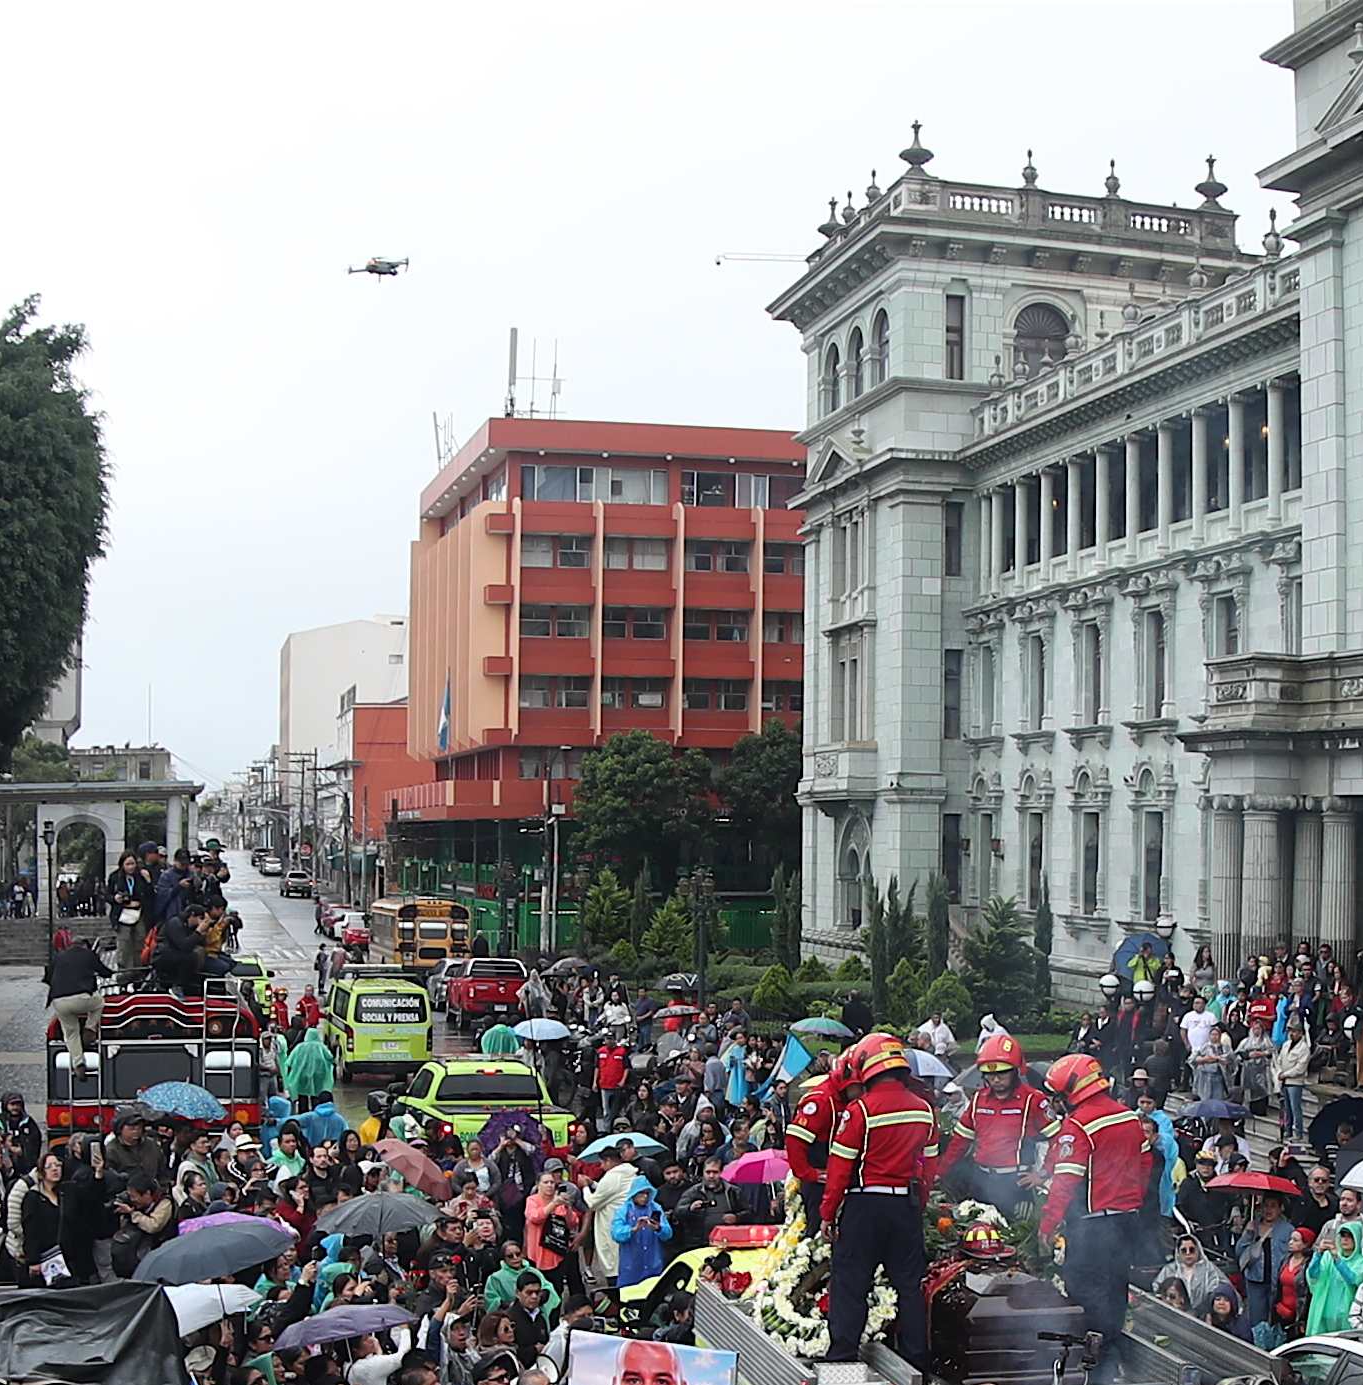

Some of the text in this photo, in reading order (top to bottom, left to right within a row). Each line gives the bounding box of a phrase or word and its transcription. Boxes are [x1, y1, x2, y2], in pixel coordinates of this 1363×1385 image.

[361, 997, 420, 1008] COMUNICACIÓN
[361, 1012, 420, 1022] SOCIAL Y PRENSA
